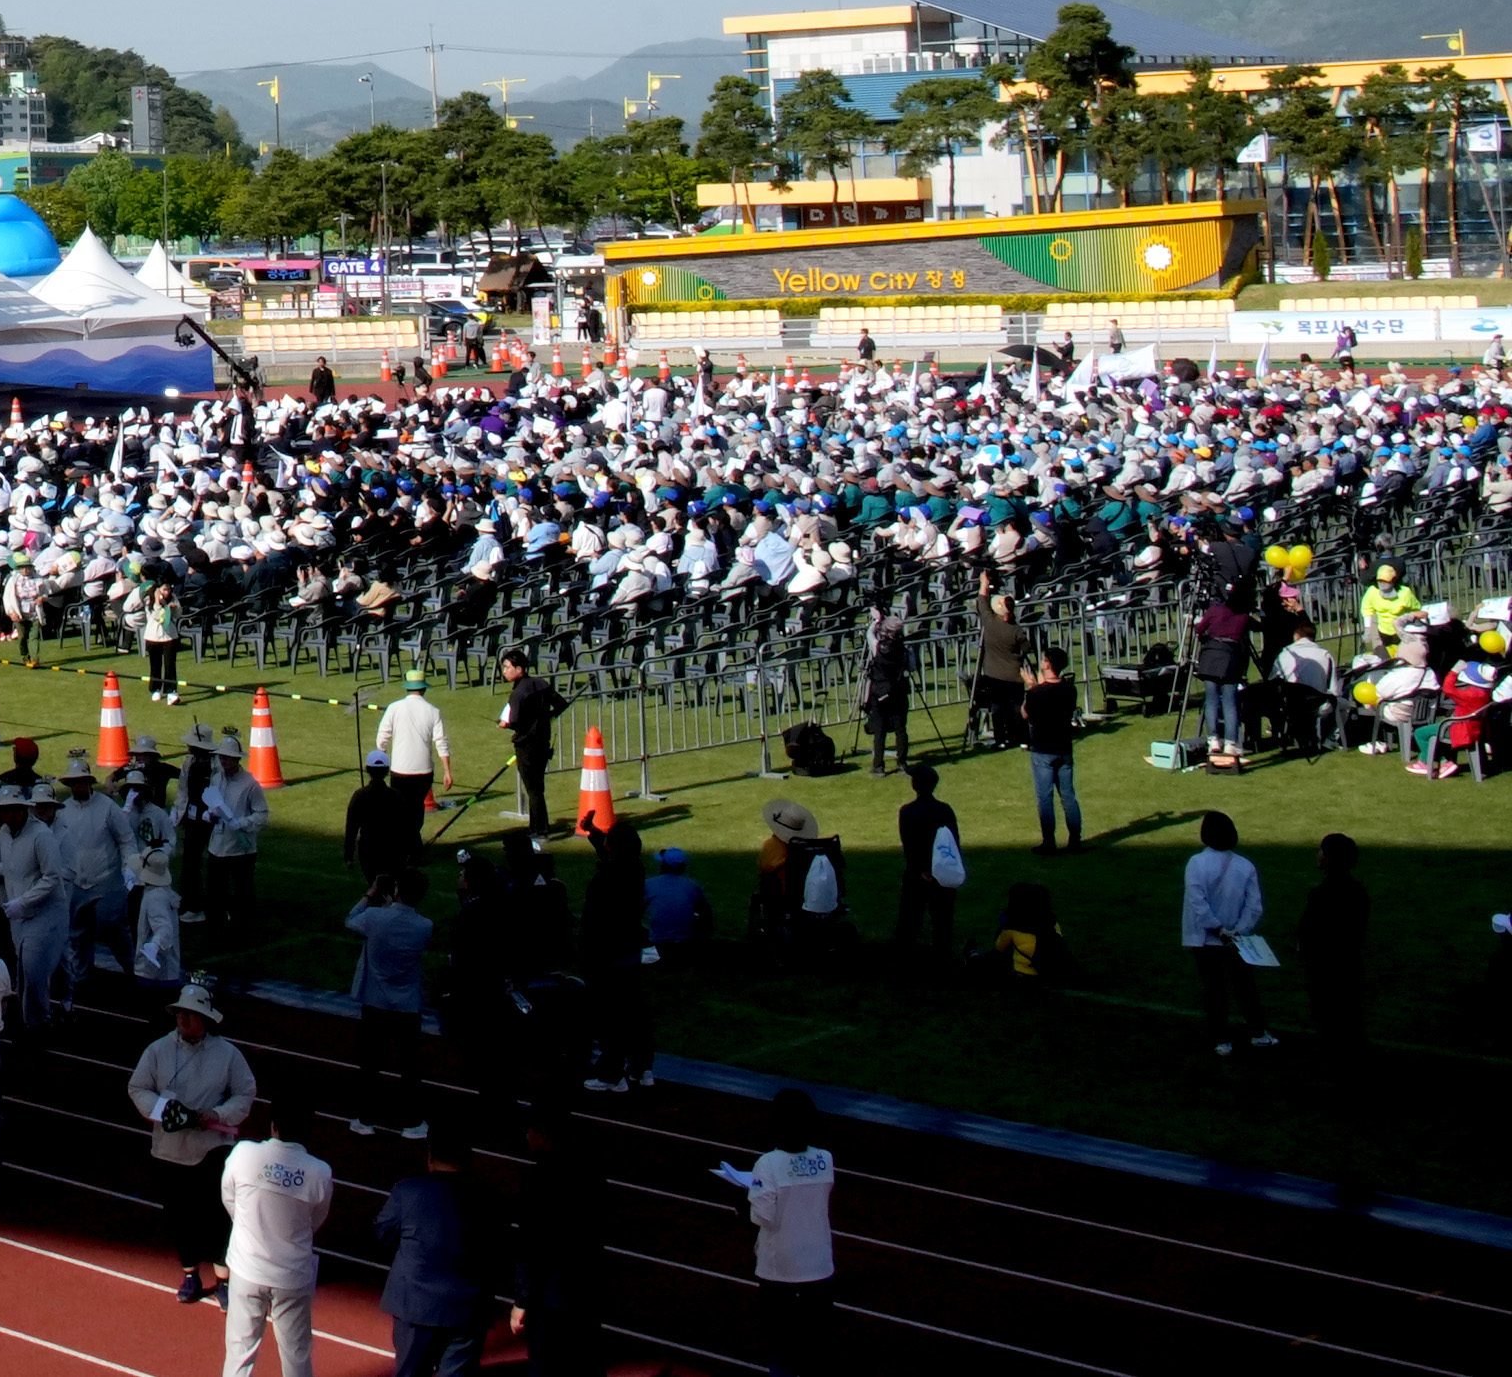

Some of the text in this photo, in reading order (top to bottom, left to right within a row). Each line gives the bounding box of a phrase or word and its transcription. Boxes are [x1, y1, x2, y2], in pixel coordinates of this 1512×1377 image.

[327, 261, 380, 273] GATE 4
[772, 267, 861, 292] Yellow
[869, 271, 919, 290] City
[1353, 318, 1405, 334] 선수단
